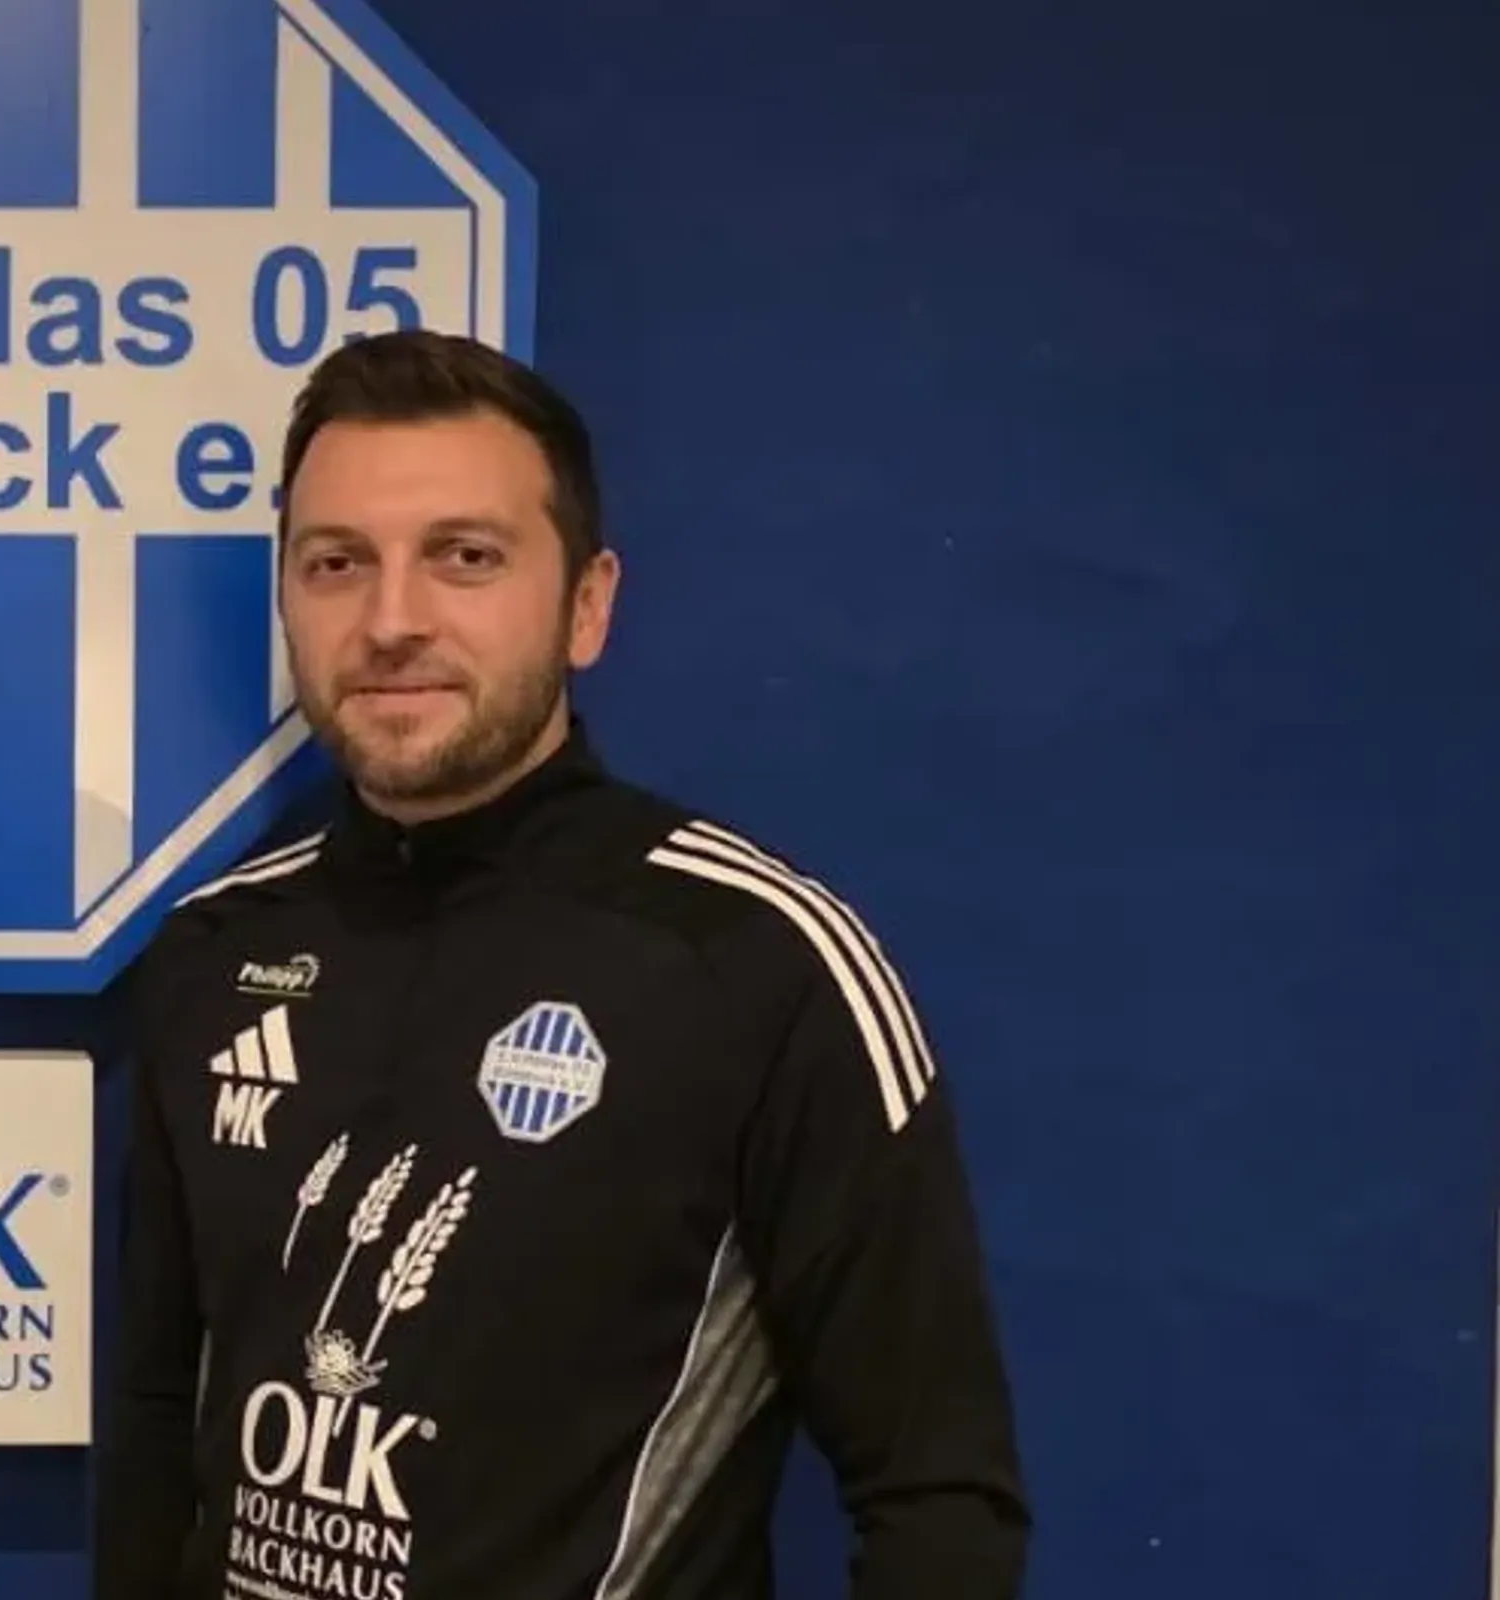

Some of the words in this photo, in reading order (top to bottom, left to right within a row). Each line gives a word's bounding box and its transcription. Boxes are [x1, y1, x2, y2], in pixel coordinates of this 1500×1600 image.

[253, 245, 422, 368] 05
[212, 1081, 283, 1149] MK
[228, 1525, 406, 1600] BACKHAUS
[234, 1483, 413, 1566] VOLLKORN
